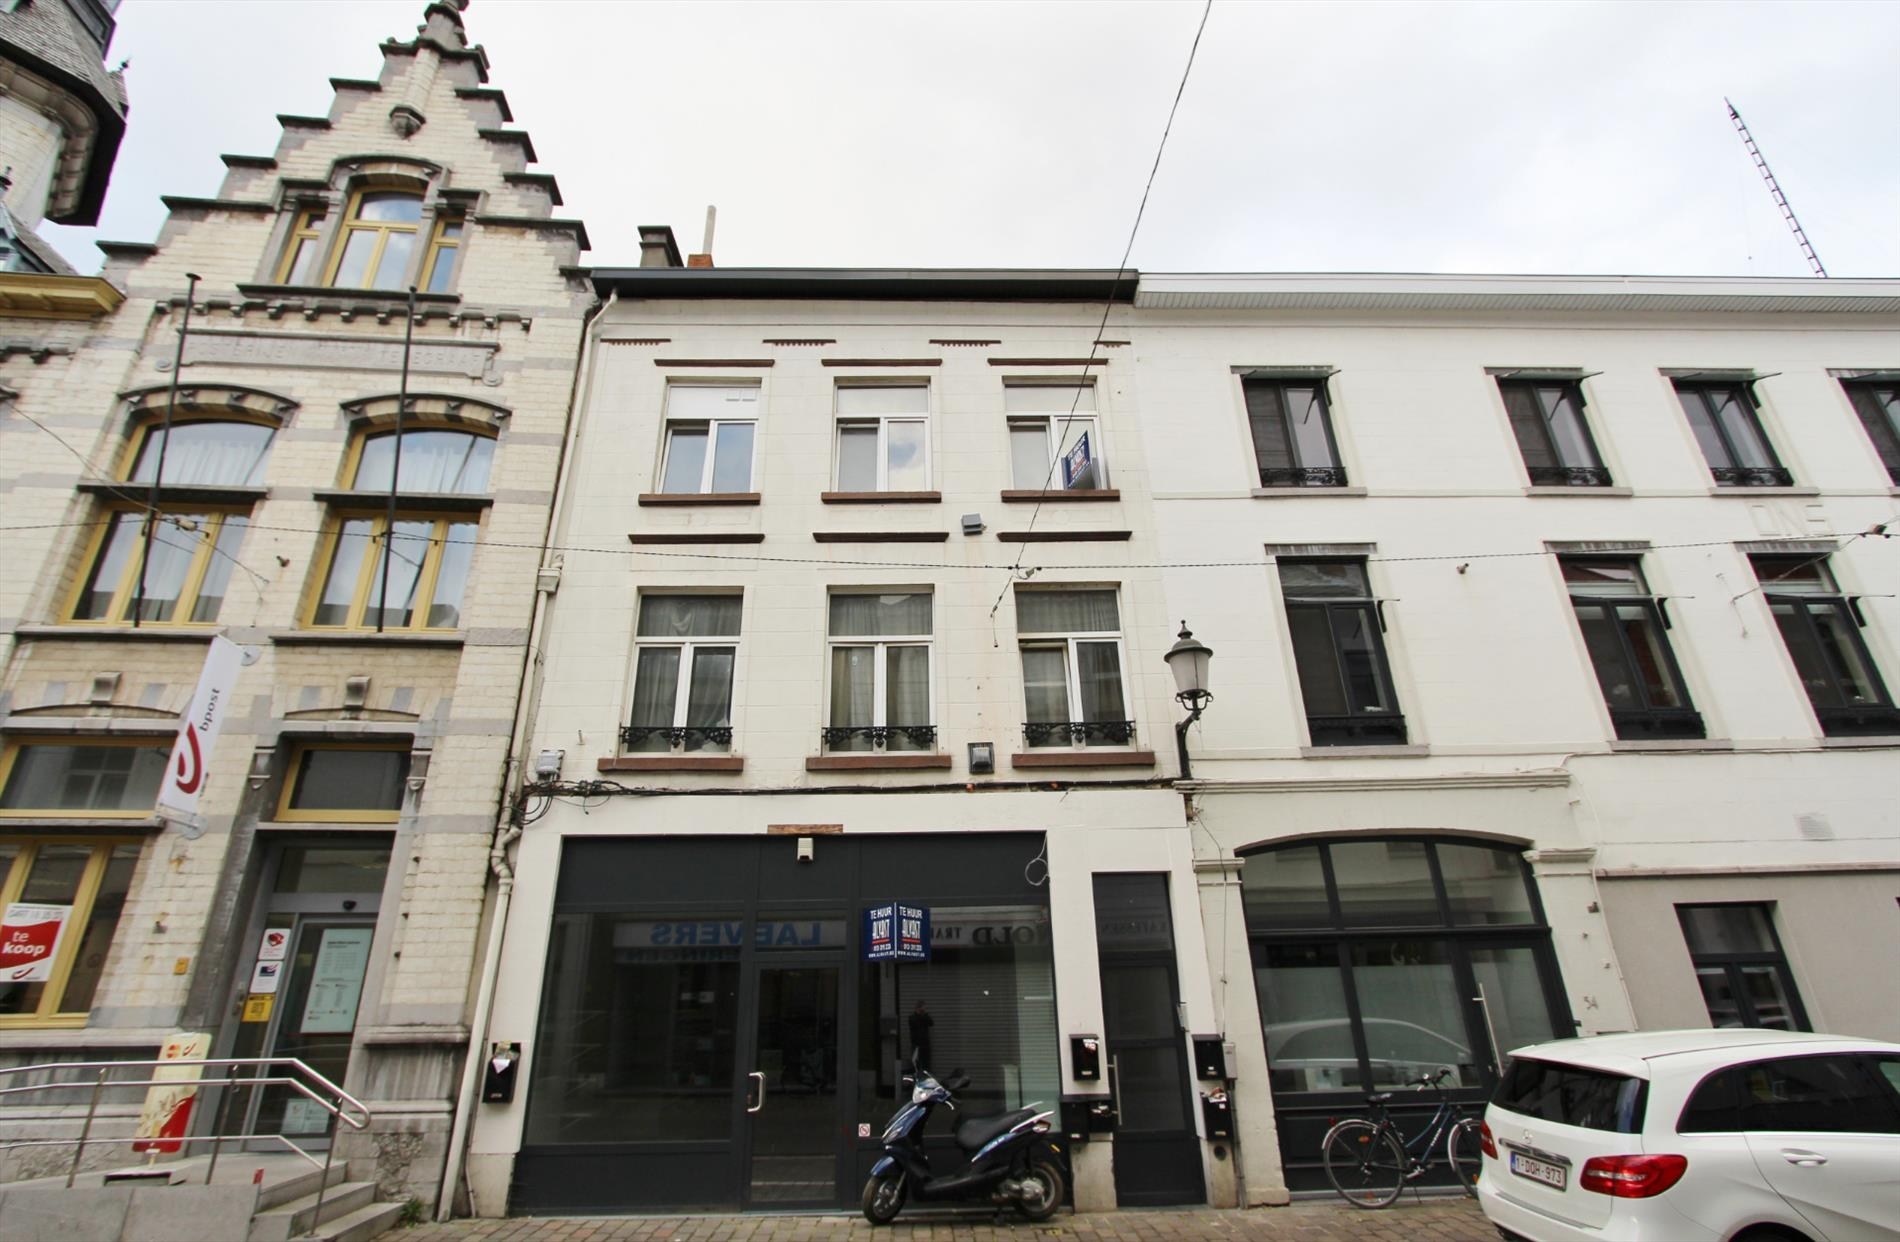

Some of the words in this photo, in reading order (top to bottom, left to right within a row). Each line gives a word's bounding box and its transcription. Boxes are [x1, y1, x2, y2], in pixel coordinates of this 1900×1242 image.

[381, 350, 481, 366] TEEGRAAF
[199, 687, 221, 732] bpost
[877, 906, 892, 918] HUUR
[906, 908, 923, 919] HUUR
[12, 931, 29, 943] te
[2, 941, 46, 957] koop
